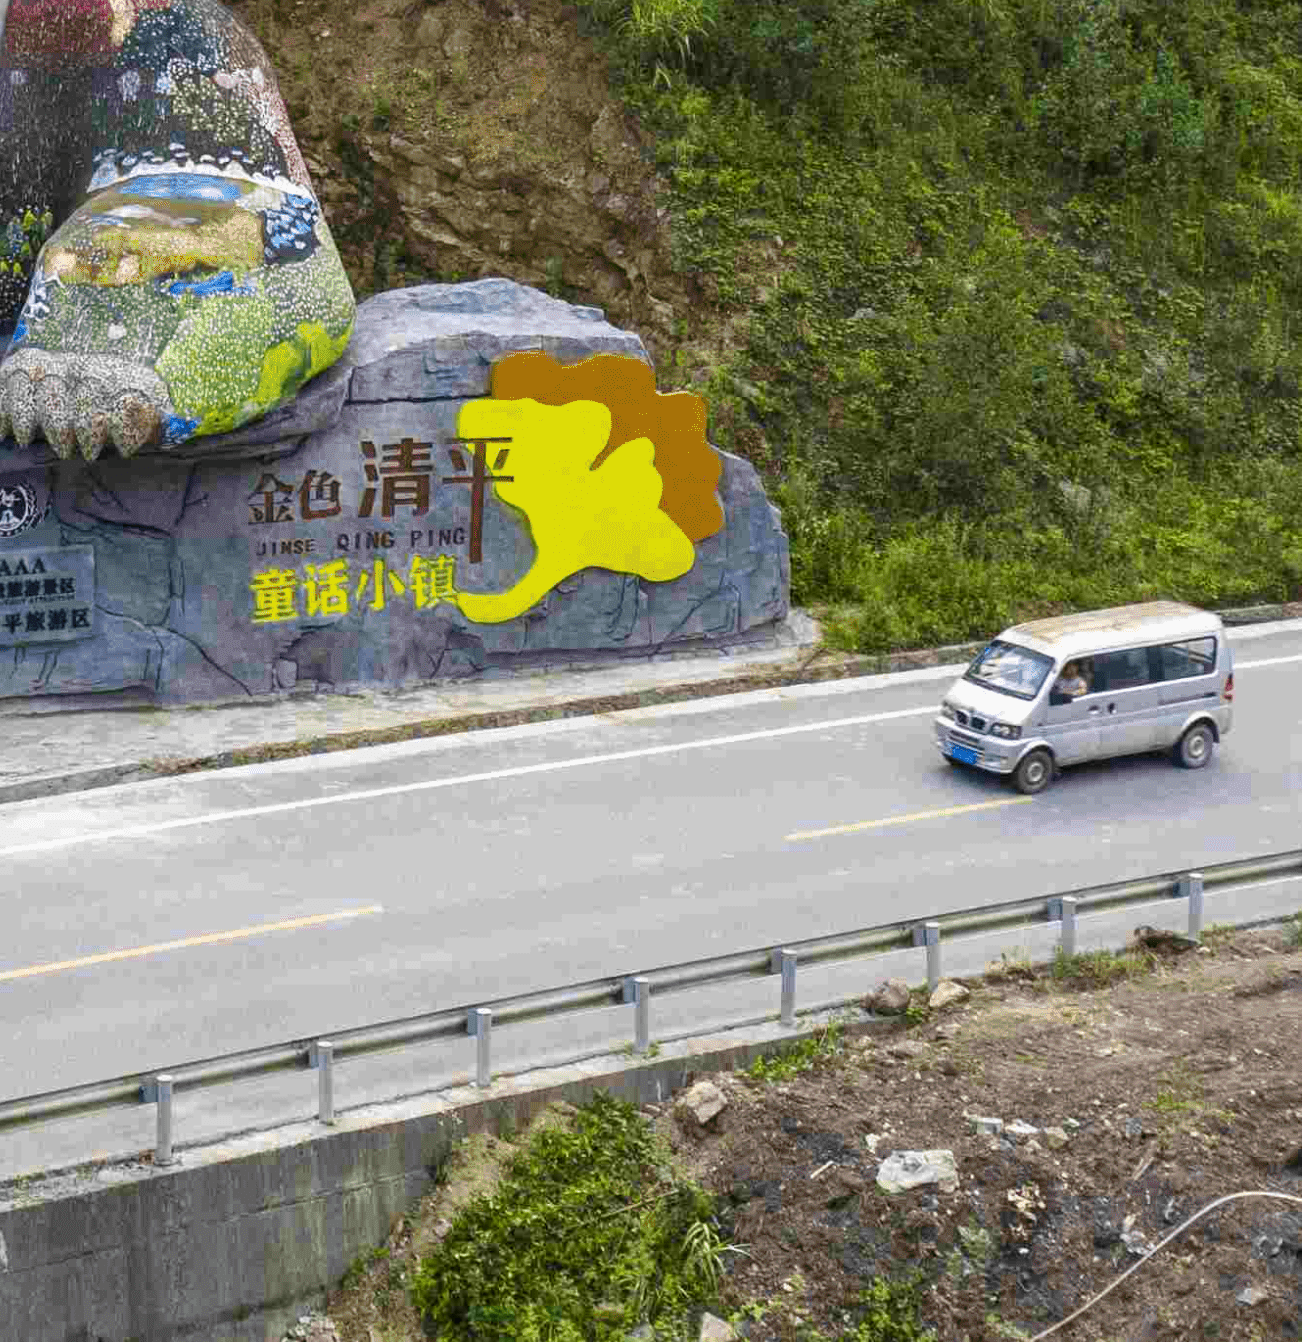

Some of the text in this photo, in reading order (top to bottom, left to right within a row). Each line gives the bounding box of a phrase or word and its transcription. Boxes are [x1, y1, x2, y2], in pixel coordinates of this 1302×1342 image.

[256, 527, 468, 556] JINSE QING PING
[250, 554, 456, 623] 童话小镇
